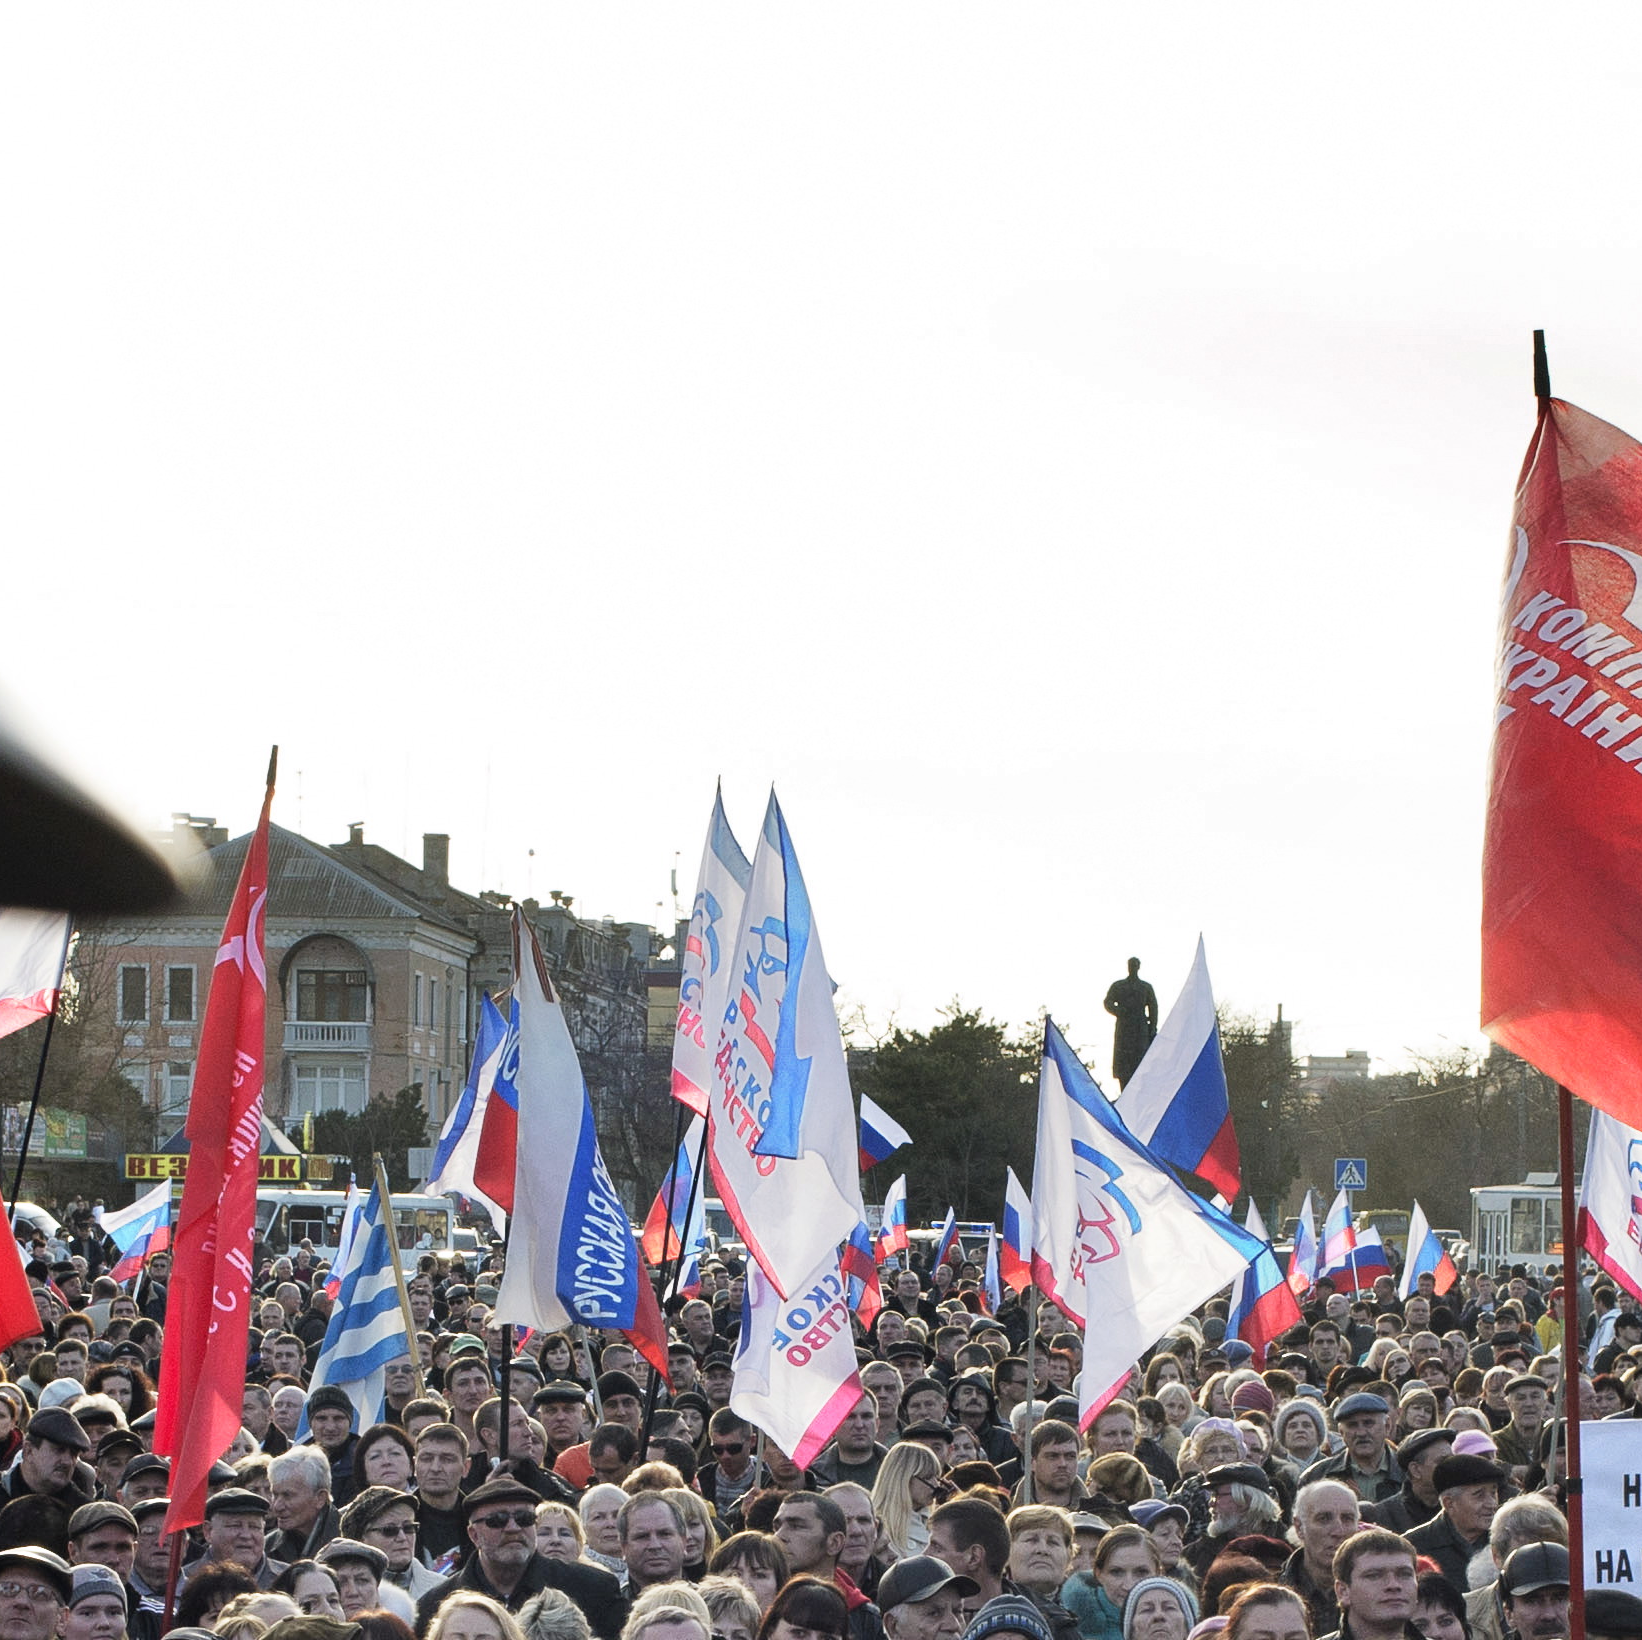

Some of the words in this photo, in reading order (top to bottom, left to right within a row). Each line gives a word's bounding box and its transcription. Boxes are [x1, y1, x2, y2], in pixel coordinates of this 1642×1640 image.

[127, 1157, 298, 1179] ВЕЗИК
[572, 1189, 626, 1319] РУССКАЯ
[1595, 1549, 1634, 1584] НА
